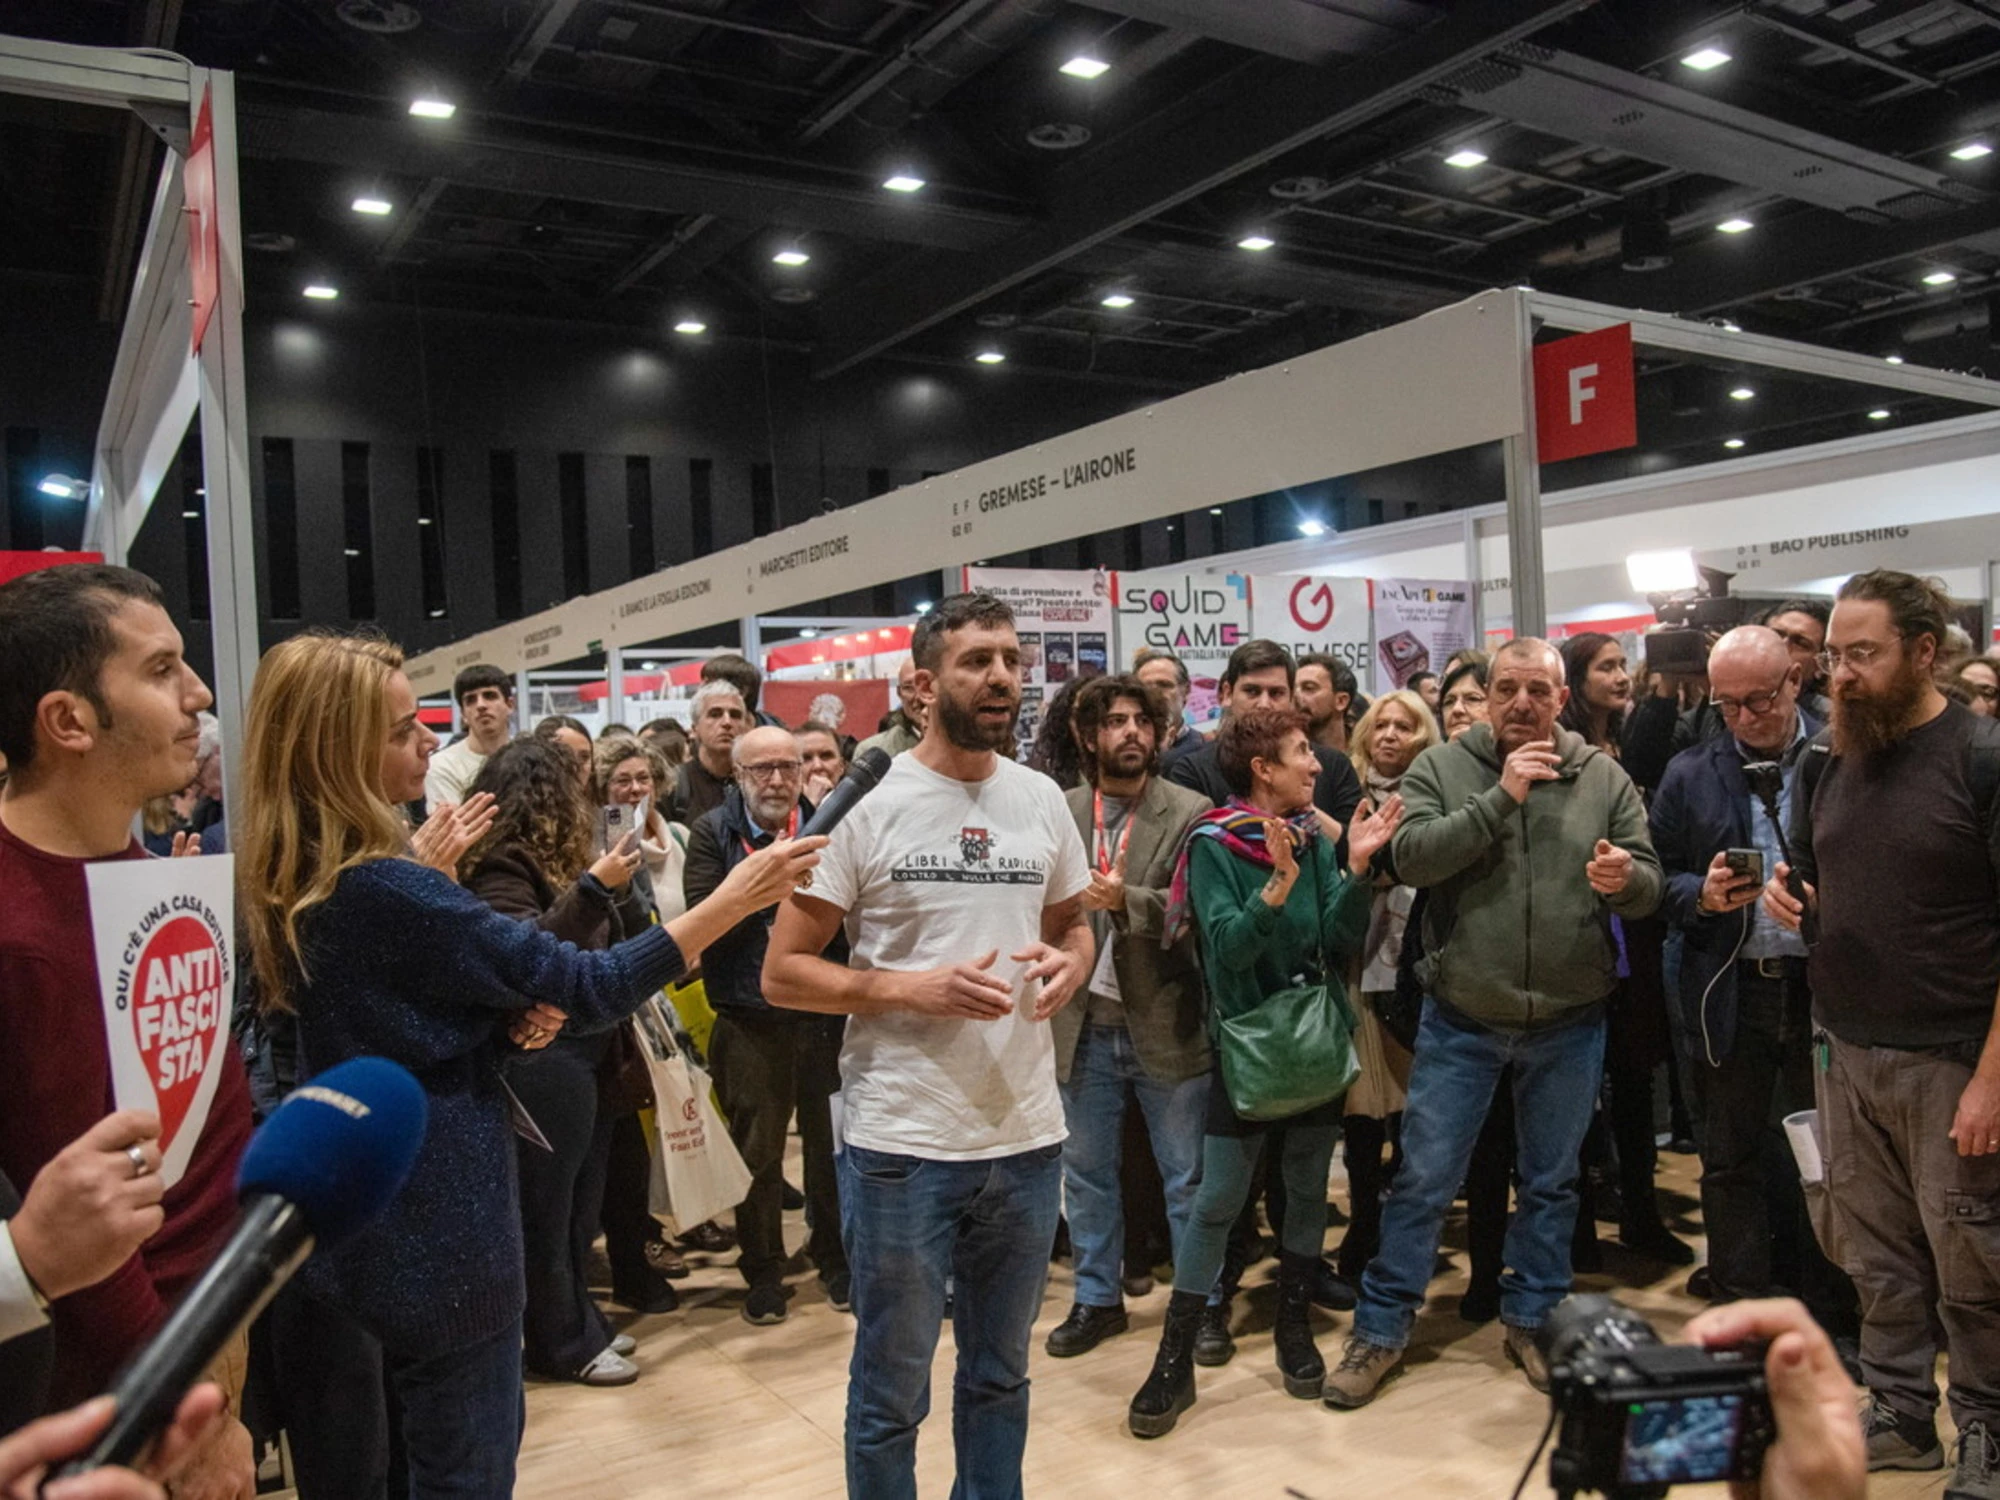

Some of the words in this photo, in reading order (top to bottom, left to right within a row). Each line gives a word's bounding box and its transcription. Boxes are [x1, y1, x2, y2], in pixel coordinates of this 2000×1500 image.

[1568, 363, 1598, 426] F
[979, 475, 1046, 513] GREMESE
[1064, 448, 1137, 489] L'AIRONE
[760, 547, 807, 577] MARCHETTI
[809, 535, 849, 563] EDITORE
[1770, 538, 1803, 555] BAO
[1808, 524, 1910, 549] PUBLISHING
[1119, 575, 1226, 614] SQUID
[1438, 591, 1466, 603] GAME
[1145, 623, 1249, 647] GAME
[1280, 643, 1368, 669] EMESE
[894, 871, 938, 880] CONTRO
[962, 874, 992, 883] NULLA
[995, 874, 1010, 882] CHE
[905, 854, 947, 868] LIBRI
[998, 857, 1046, 872] RADICALI
[115, 968, 130, 1011] QUI
[123, 930, 144, 965] C'È
[139, 901, 170, 933] UNA
[172, 894, 203, 915] CASA
[204, 906, 230, 984] EDITRICE
[144, 947, 215, 1005] ANTI
[136, 987, 219, 1052] FASCI
[158, 1034, 203, 1090] STA
